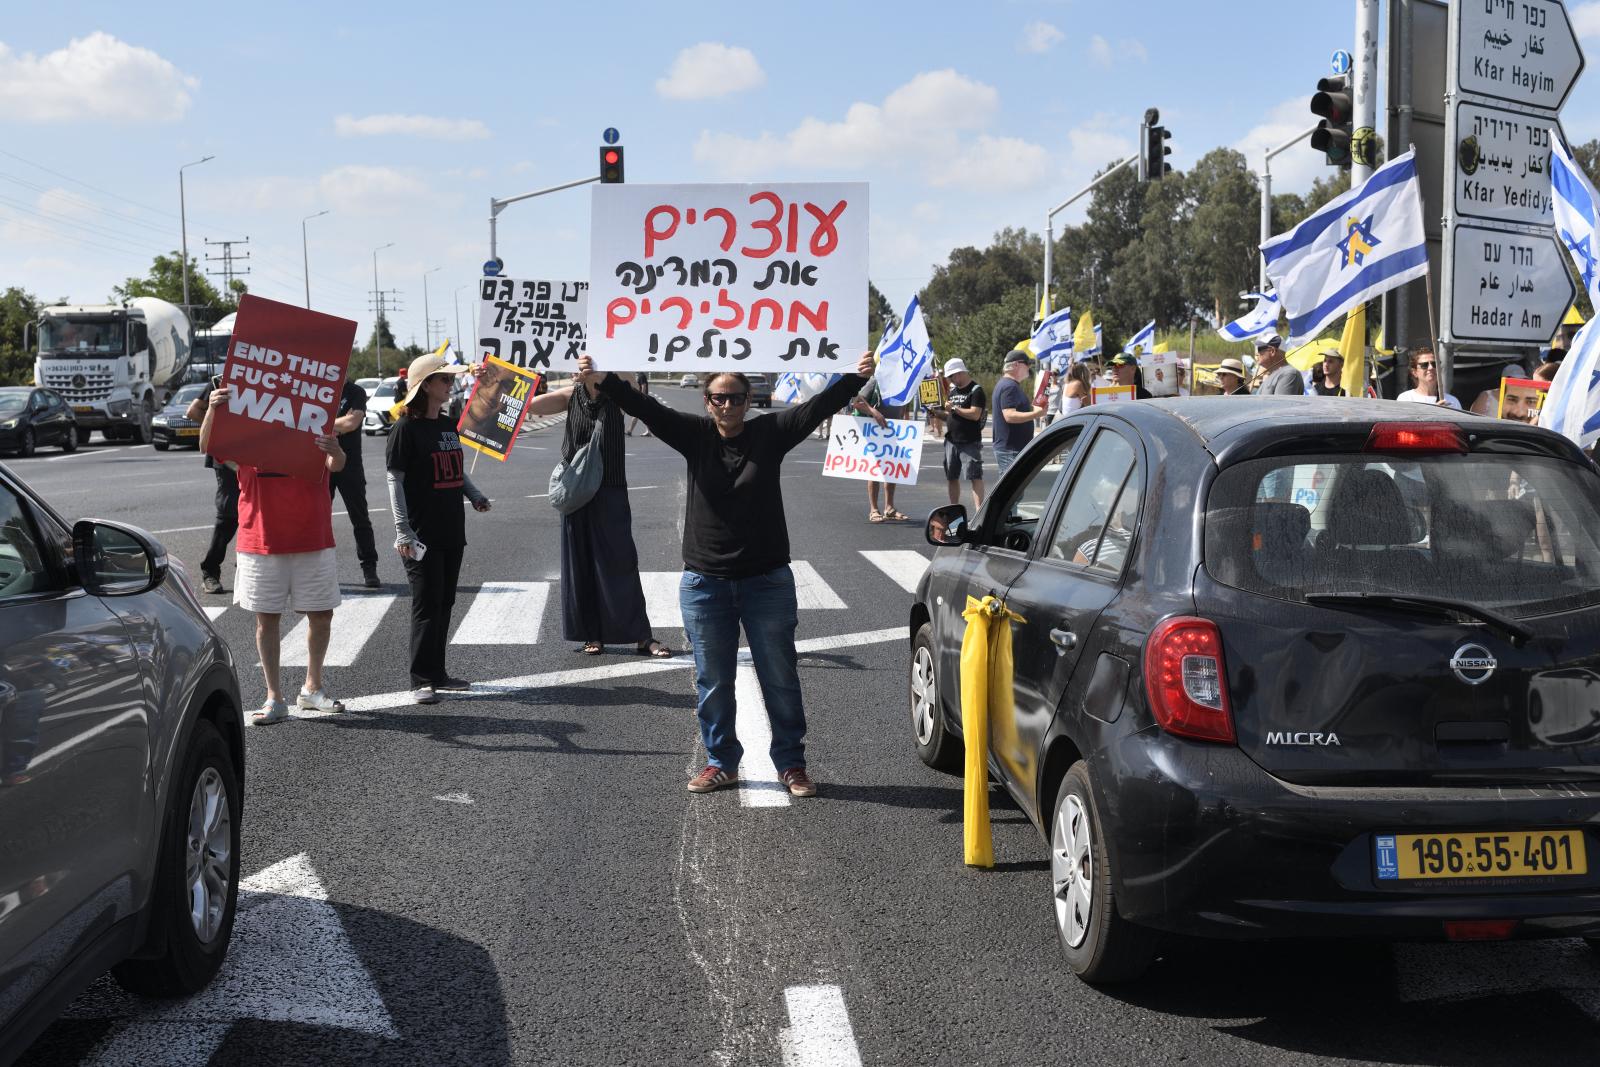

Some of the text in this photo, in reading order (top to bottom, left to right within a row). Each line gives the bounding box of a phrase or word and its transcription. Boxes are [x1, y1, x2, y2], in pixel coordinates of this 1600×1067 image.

[1485, 0, 1546, 28] כפר חיים
[1521, 34, 1545, 59] كفار
[1474, 56, 1554, 93] Kfar Hayim
[1474, 115, 1549, 148] כפר ידידיה
[1521, 154, 1544, 179] كفار
[1463, 180, 1495, 203] Kfar
[644, 191, 848, 259] עוצרים
[1484, 242, 1533, 266] הדר עם
[615, 255, 819, 295] את המדינה
[1480, 271, 1534, 299] هدار عام
[481, 279, 514, 301] גם
[522, 281, 551, 301] פה
[493, 301, 567, 328] בשבילך
[606, 288, 829, 339] מחזירים
[1471, 305, 1541, 329] Hadar Am
[504, 319, 587, 341] מקרה זה
[647, 328, 840, 362] את כולם!
[233, 341, 341, 381] END THIS
[510, 375, 531, 401] אל
[226, 383, 329, 436] WAR
[863, 441, 913, 459] אותם
[825, 453, 911, 479] מהגהנום!
[1455, 659, 1494, 667] NISSAN
[1265, 731, 1341, 746] MICRA
[1380, 848, 1394, 867] IL
